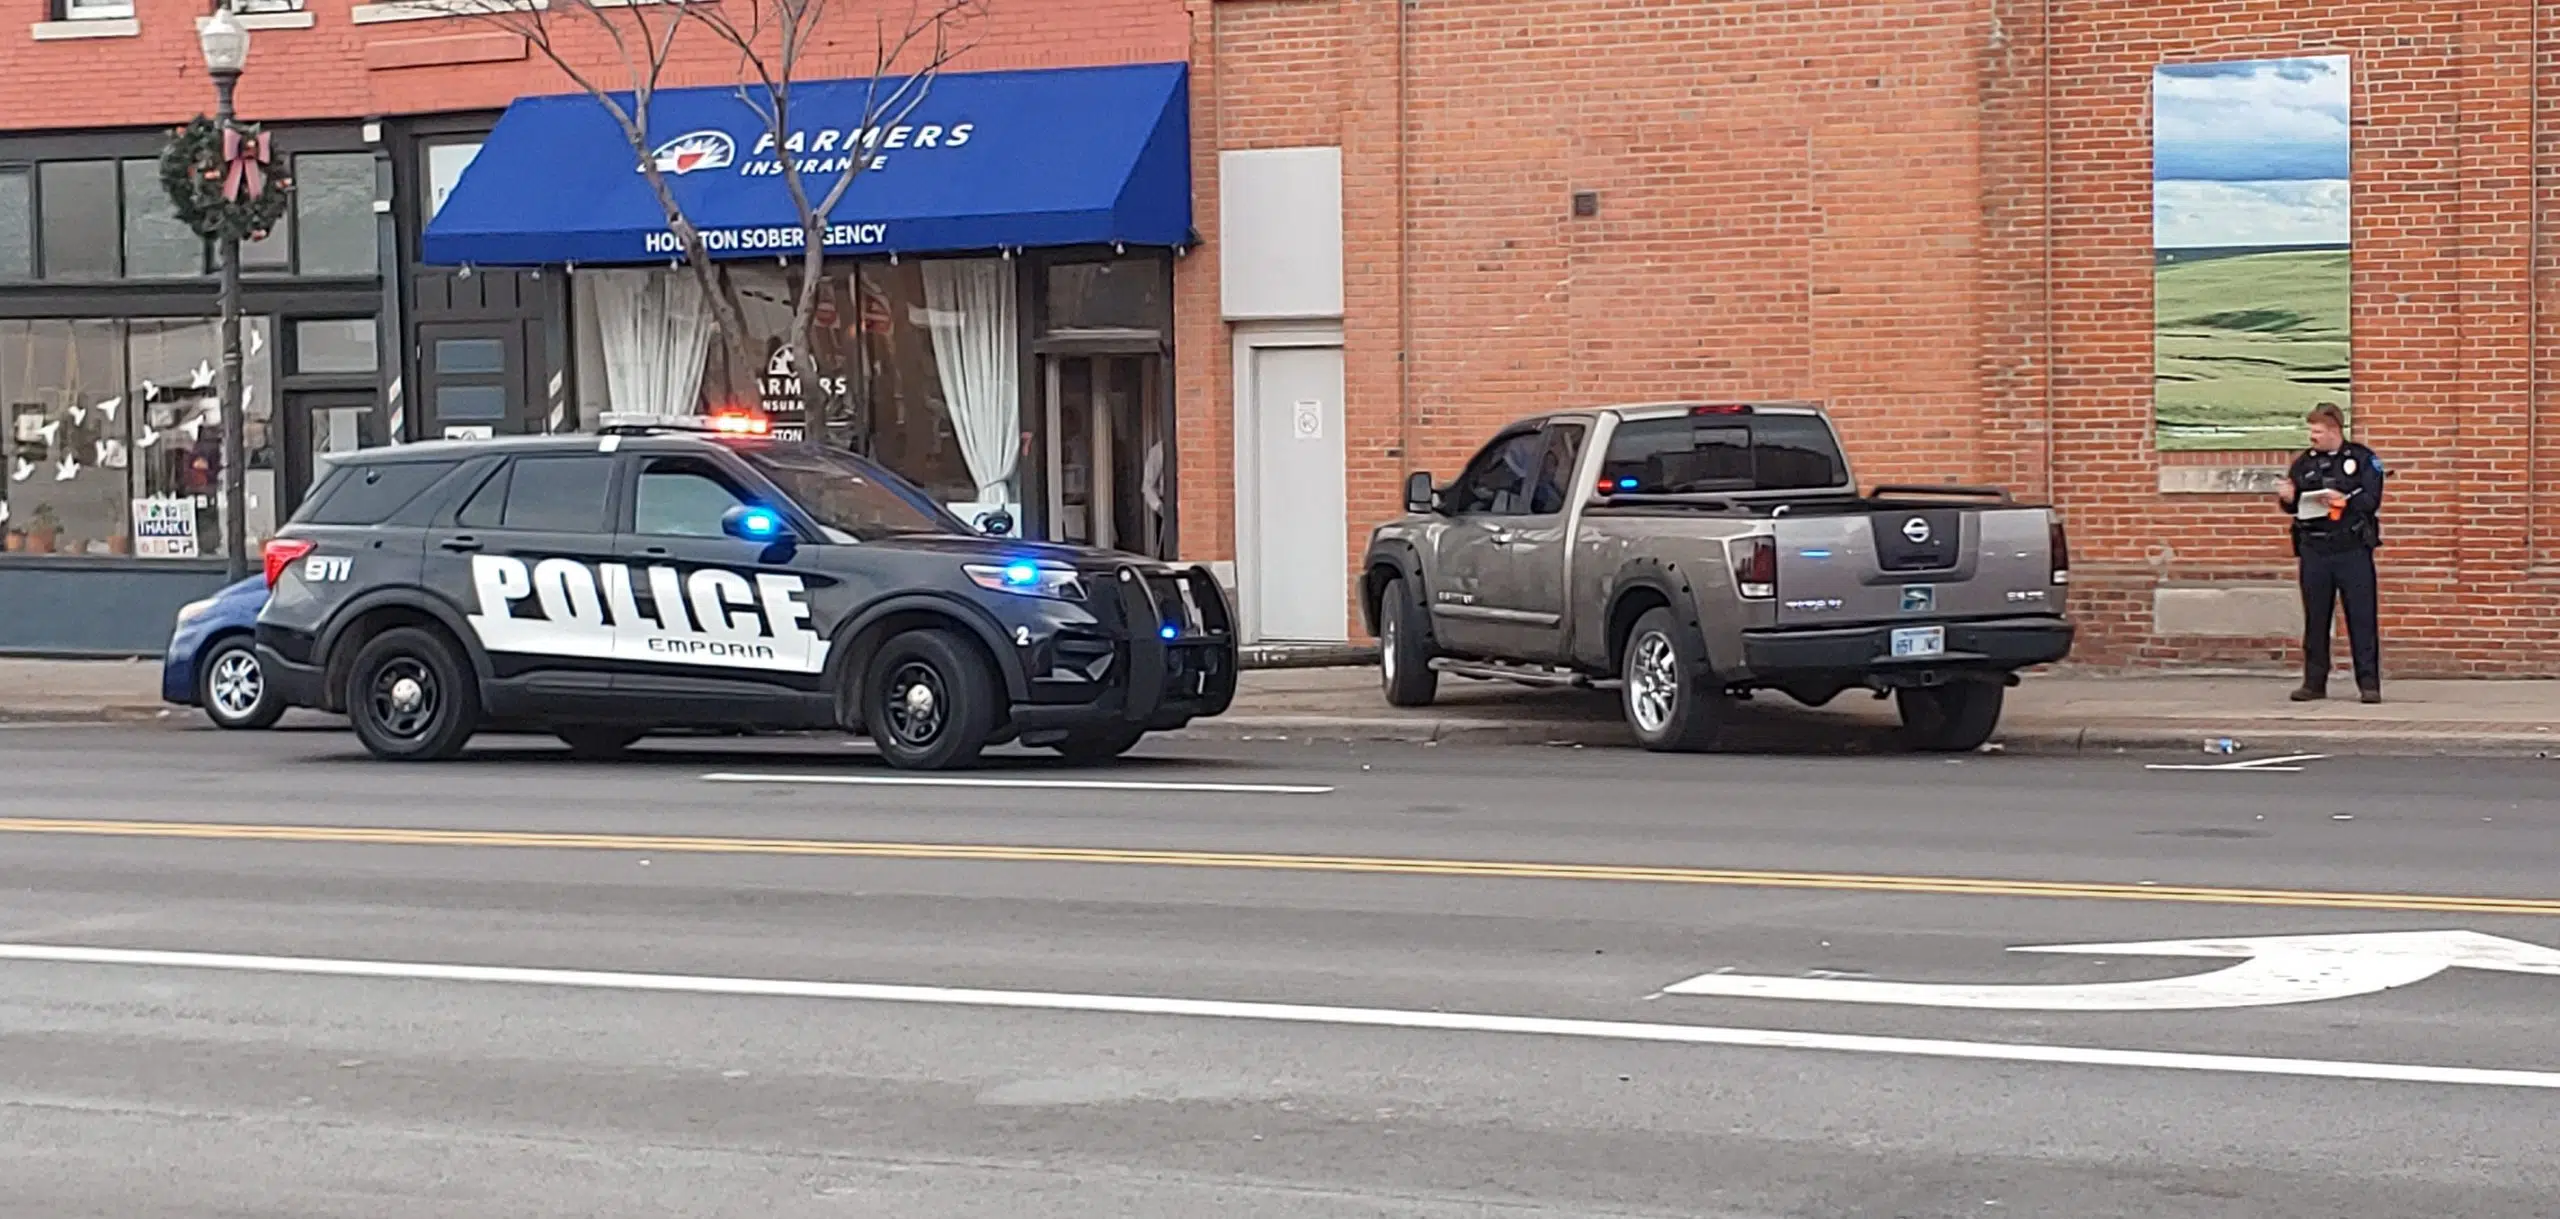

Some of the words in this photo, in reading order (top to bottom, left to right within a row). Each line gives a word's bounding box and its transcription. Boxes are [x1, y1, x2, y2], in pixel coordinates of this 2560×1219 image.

[752, 123, 974, 156] FARMERS
[740, 155, 888, 176] INSRANE
[646, 231, 739, 252] HOUTON
[741, 228, 804, 248] SOBER
[820, 223, 886, 245] GENCY
[756, 377, 847, 396] RMRS
[305, 555, 354, 581] 911
[472, 554, 816, 638] POLICE
[1015, 626, 1030, 646] 2
[647, 637, 775, 660] EMPORIA
